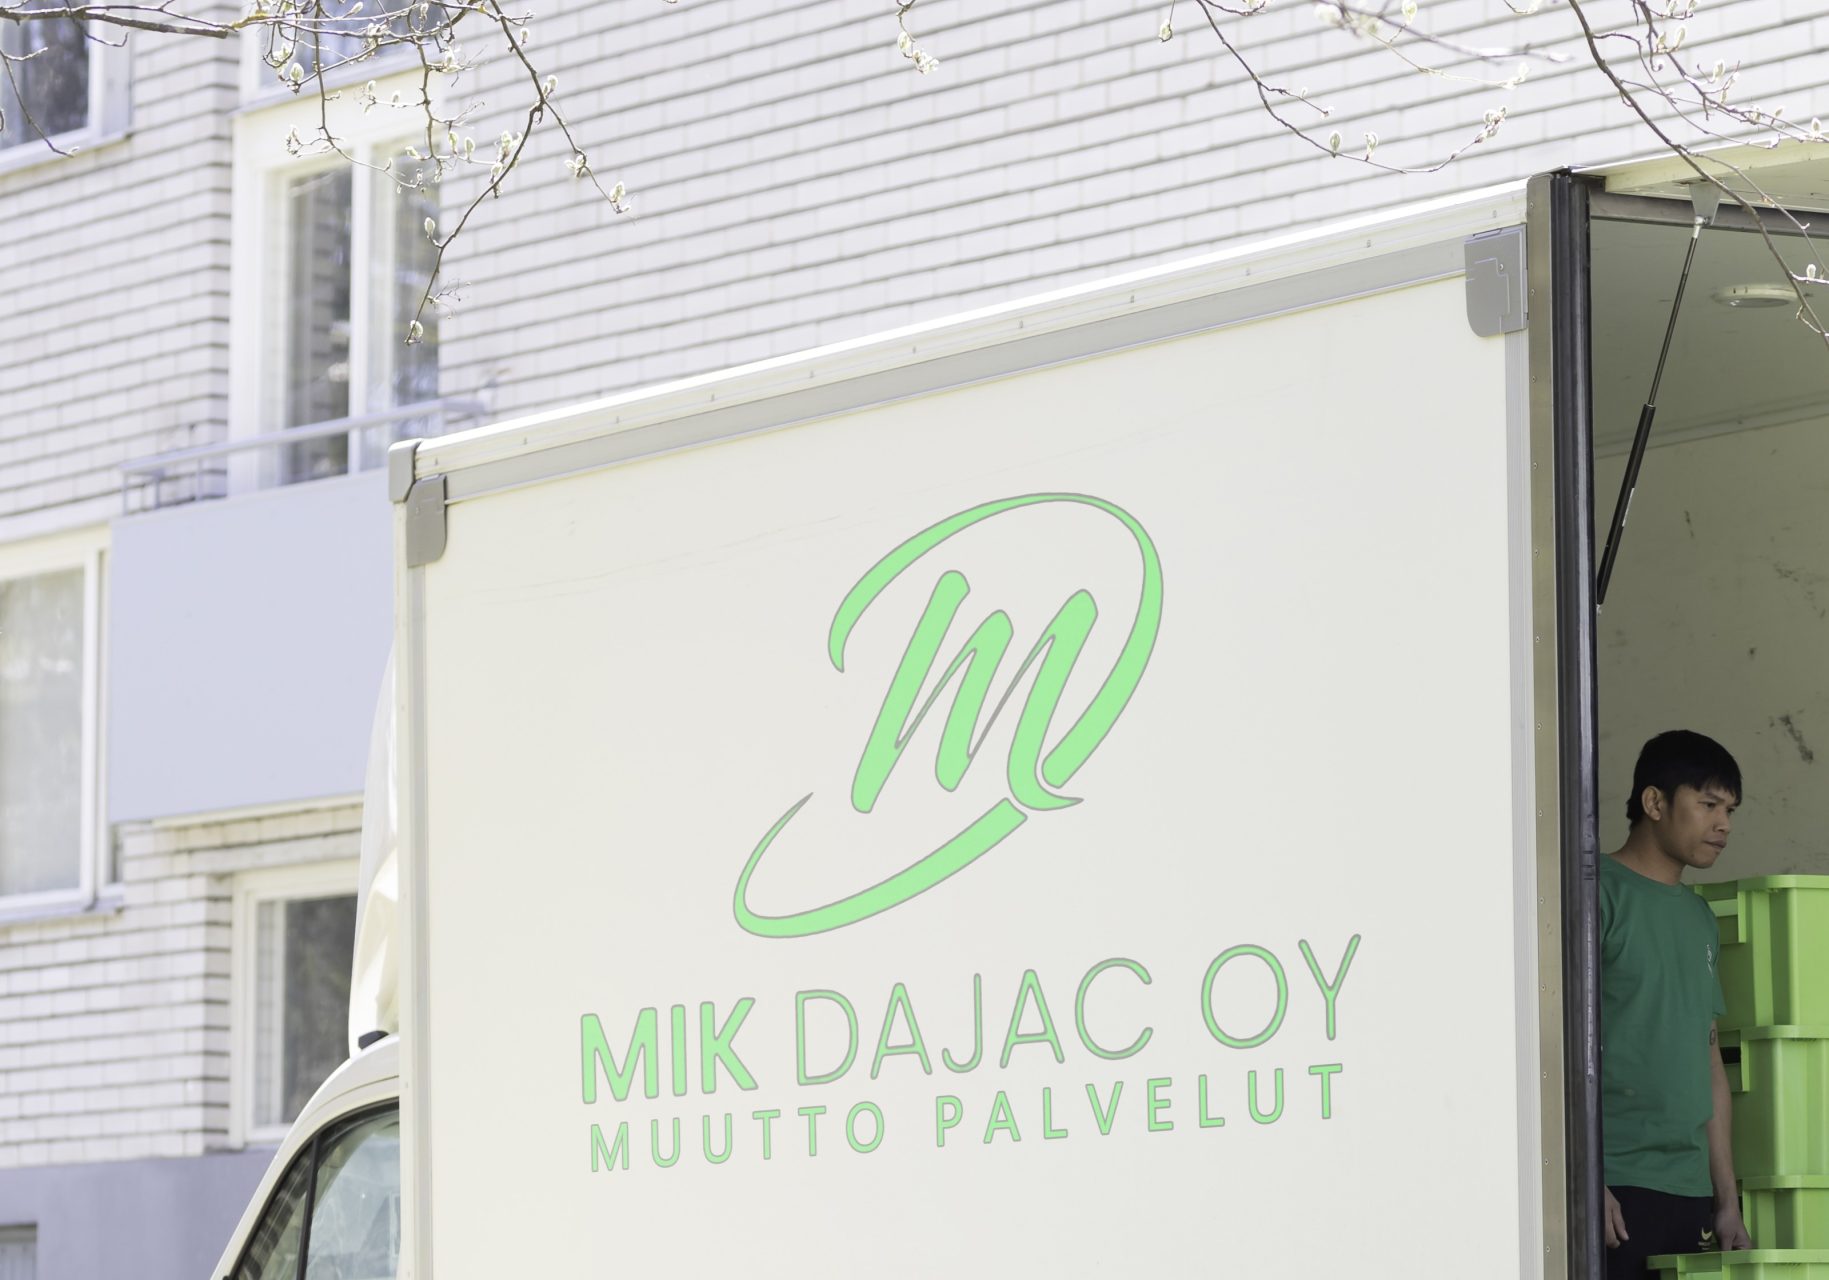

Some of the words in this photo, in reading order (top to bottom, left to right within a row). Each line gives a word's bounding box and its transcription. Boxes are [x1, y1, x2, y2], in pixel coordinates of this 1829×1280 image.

[580, 996, 757, 1104] MIK
[794, 956, 1154, 1086] DAJAC
[1200, 933, 1361, 1050] OY
[590, 1101, 886, 1172] MUUTTO
[935, 1062, 1344, 1147] PALVELUT
